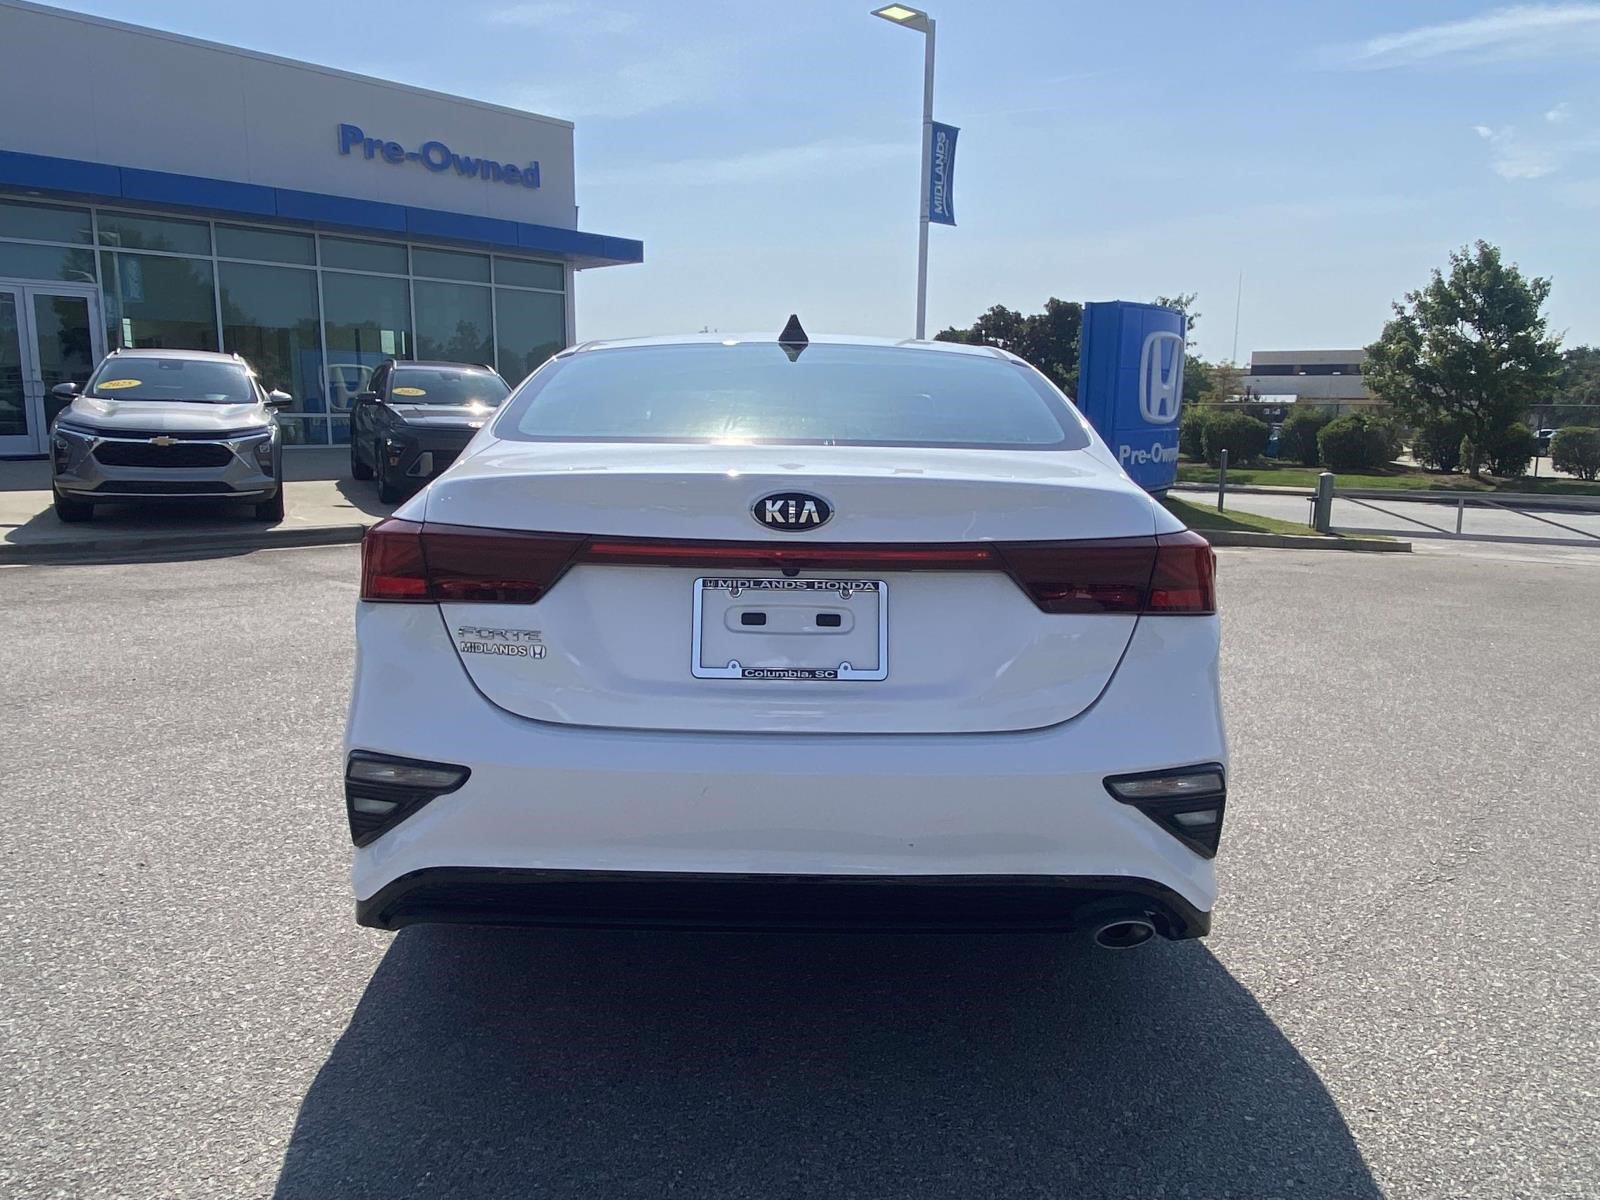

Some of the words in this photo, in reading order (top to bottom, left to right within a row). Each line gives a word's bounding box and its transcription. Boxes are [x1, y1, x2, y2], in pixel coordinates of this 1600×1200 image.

[337, 123, 541, 189] Pre-Owned
[934, 132, 946, 213] MIDLANDS
[765, 500, 821, 524] KIA
[718, 580, 808, 590] MIDLANDS
[814, 581, 876, 591] HONDA
[458, 626, 542, 642] FORTE
[460, 641, 528, 657] MIDLANDS
[815, 670, 836, 679] SC
